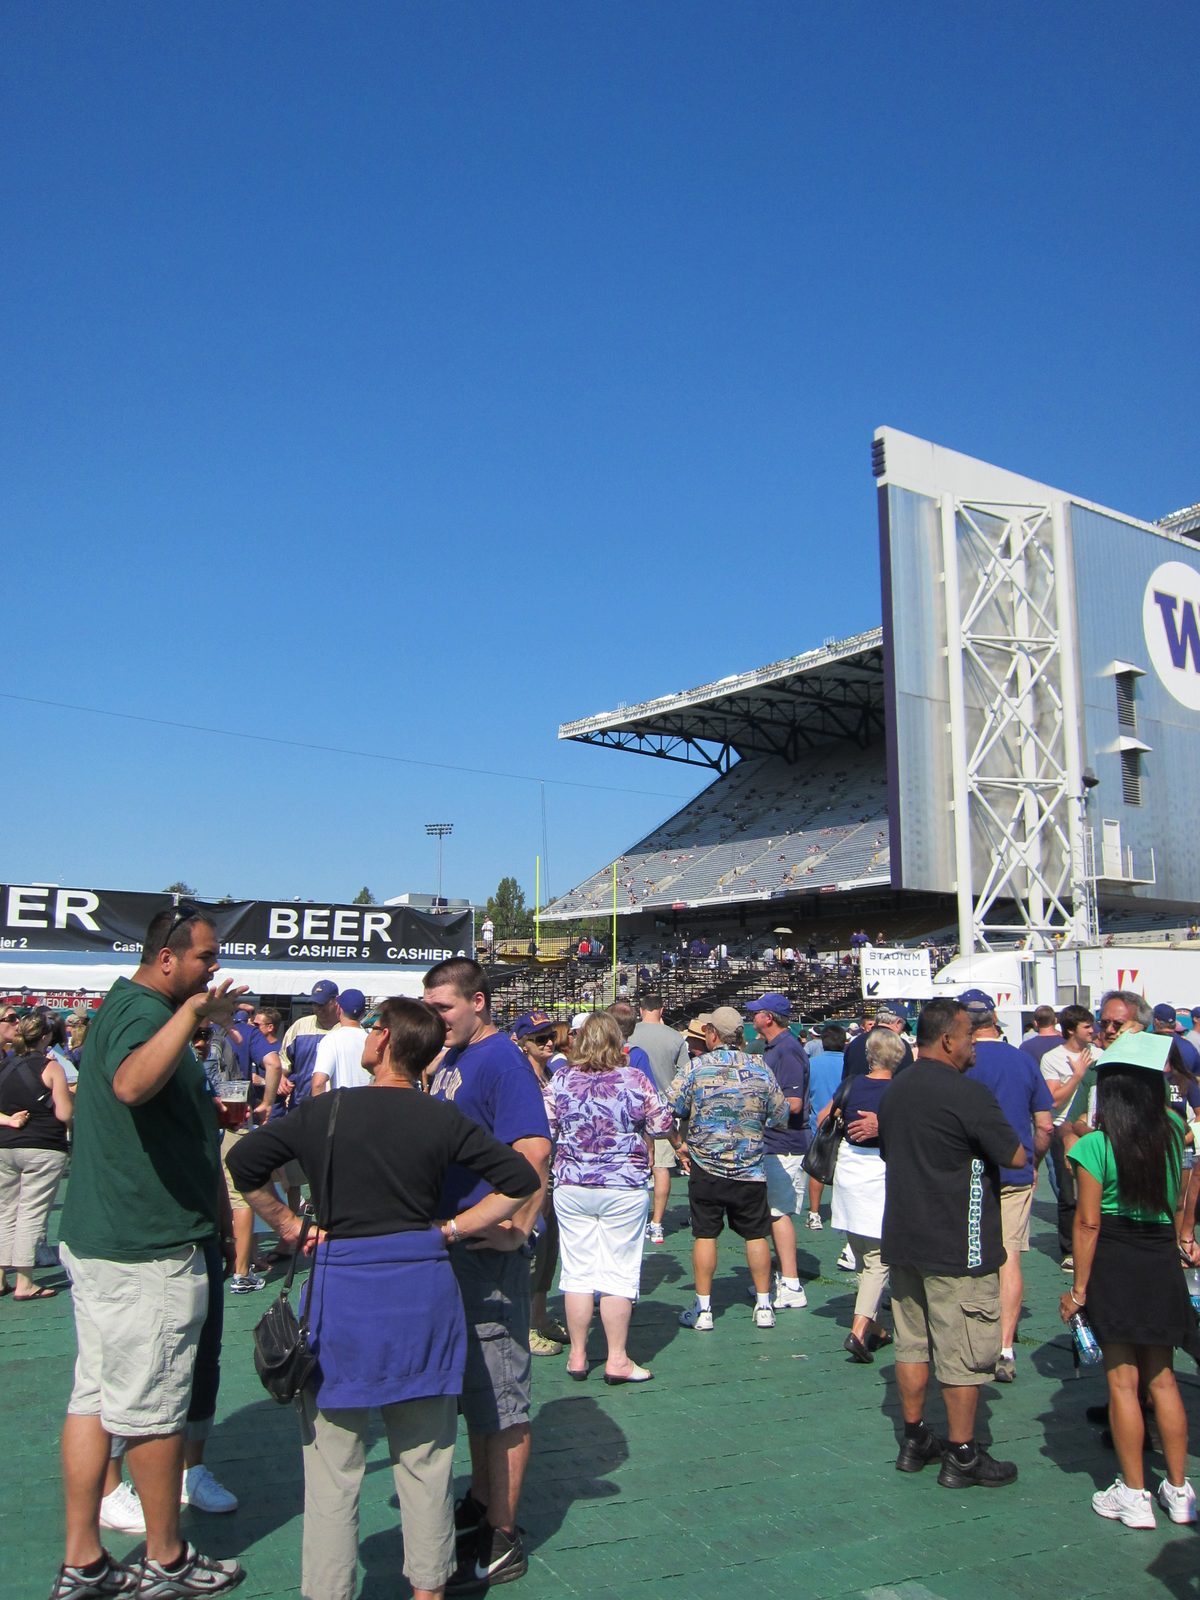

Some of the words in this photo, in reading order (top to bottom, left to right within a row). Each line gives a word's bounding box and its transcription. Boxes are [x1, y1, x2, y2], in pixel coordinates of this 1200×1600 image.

[6, 886, 101, 931] ER
[268, 908, 392, 942] BEER
[0, 936, 17, 949] ier
[20, 937, 28, 948] 2
[112, 941, 144, 952] Cash
[219, 943, 257, 955] HIER
[260, 944, 271, 956] 4
[288, 944, 357, 957] CASHIER
[361, 946, 370, 957] 5
[386, 947, 453, 961] CASHIER
[457, 949, 466, 958] 6
[869, 952, 921, 961] STADIUM
[864, 967, 928, 977] ENTRANCE
[72, 998, 93, 1010] ONE
[967, 1158, 985, 1269] WARRIORS
